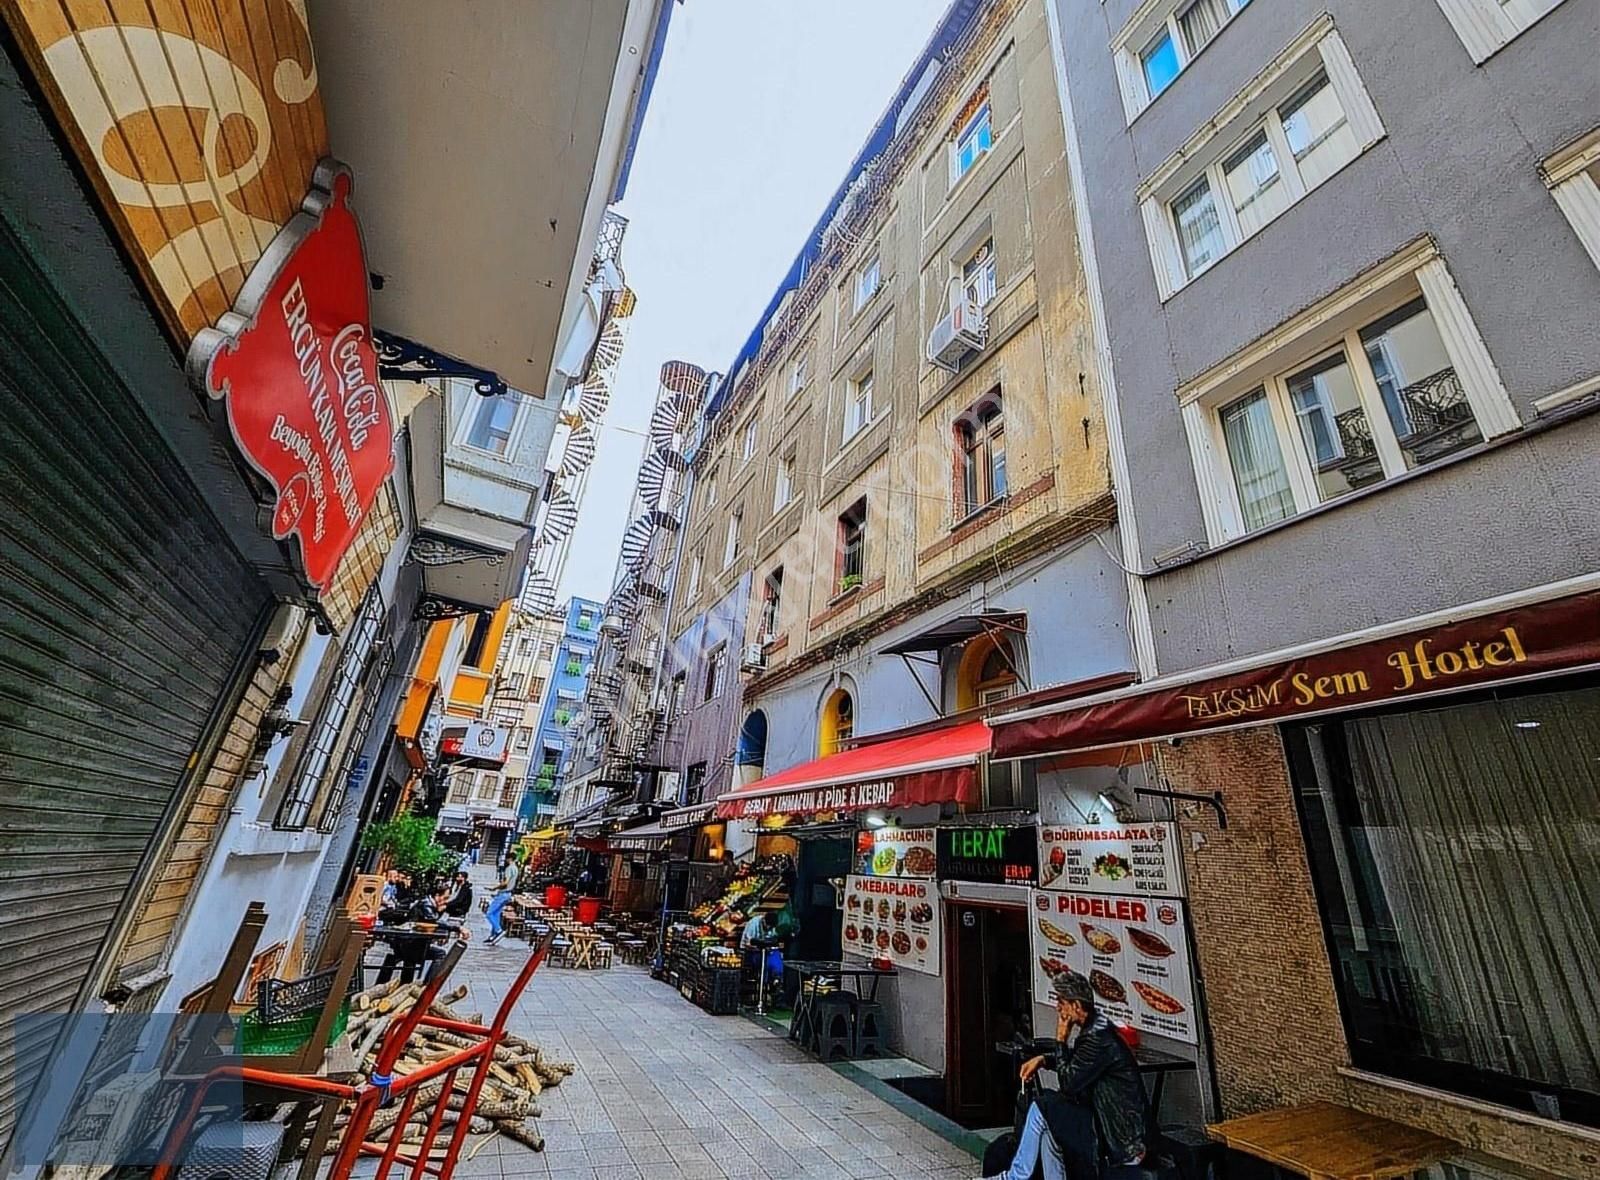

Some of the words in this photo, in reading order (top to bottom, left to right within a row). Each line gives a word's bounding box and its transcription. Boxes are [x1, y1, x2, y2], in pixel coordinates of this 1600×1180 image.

[281, 275, 324, 398] ERGÜN
[312, 382, 337, 455] KAYA
[328, 436, 363, 530] MEŞRUBAT
[330, 323, 380, 451] Coca-Cola
[270, 414, 313, 466] Beyoğlu
[1292, 671, 1370, 706] Sem
[1387, 627, 1528, 692] Hotel
[857, 782, 895, 806] KEBAP
[874, 829, 925, 842] LAHMACUN
[862, 880, 917, 897] KEBAPLAR
